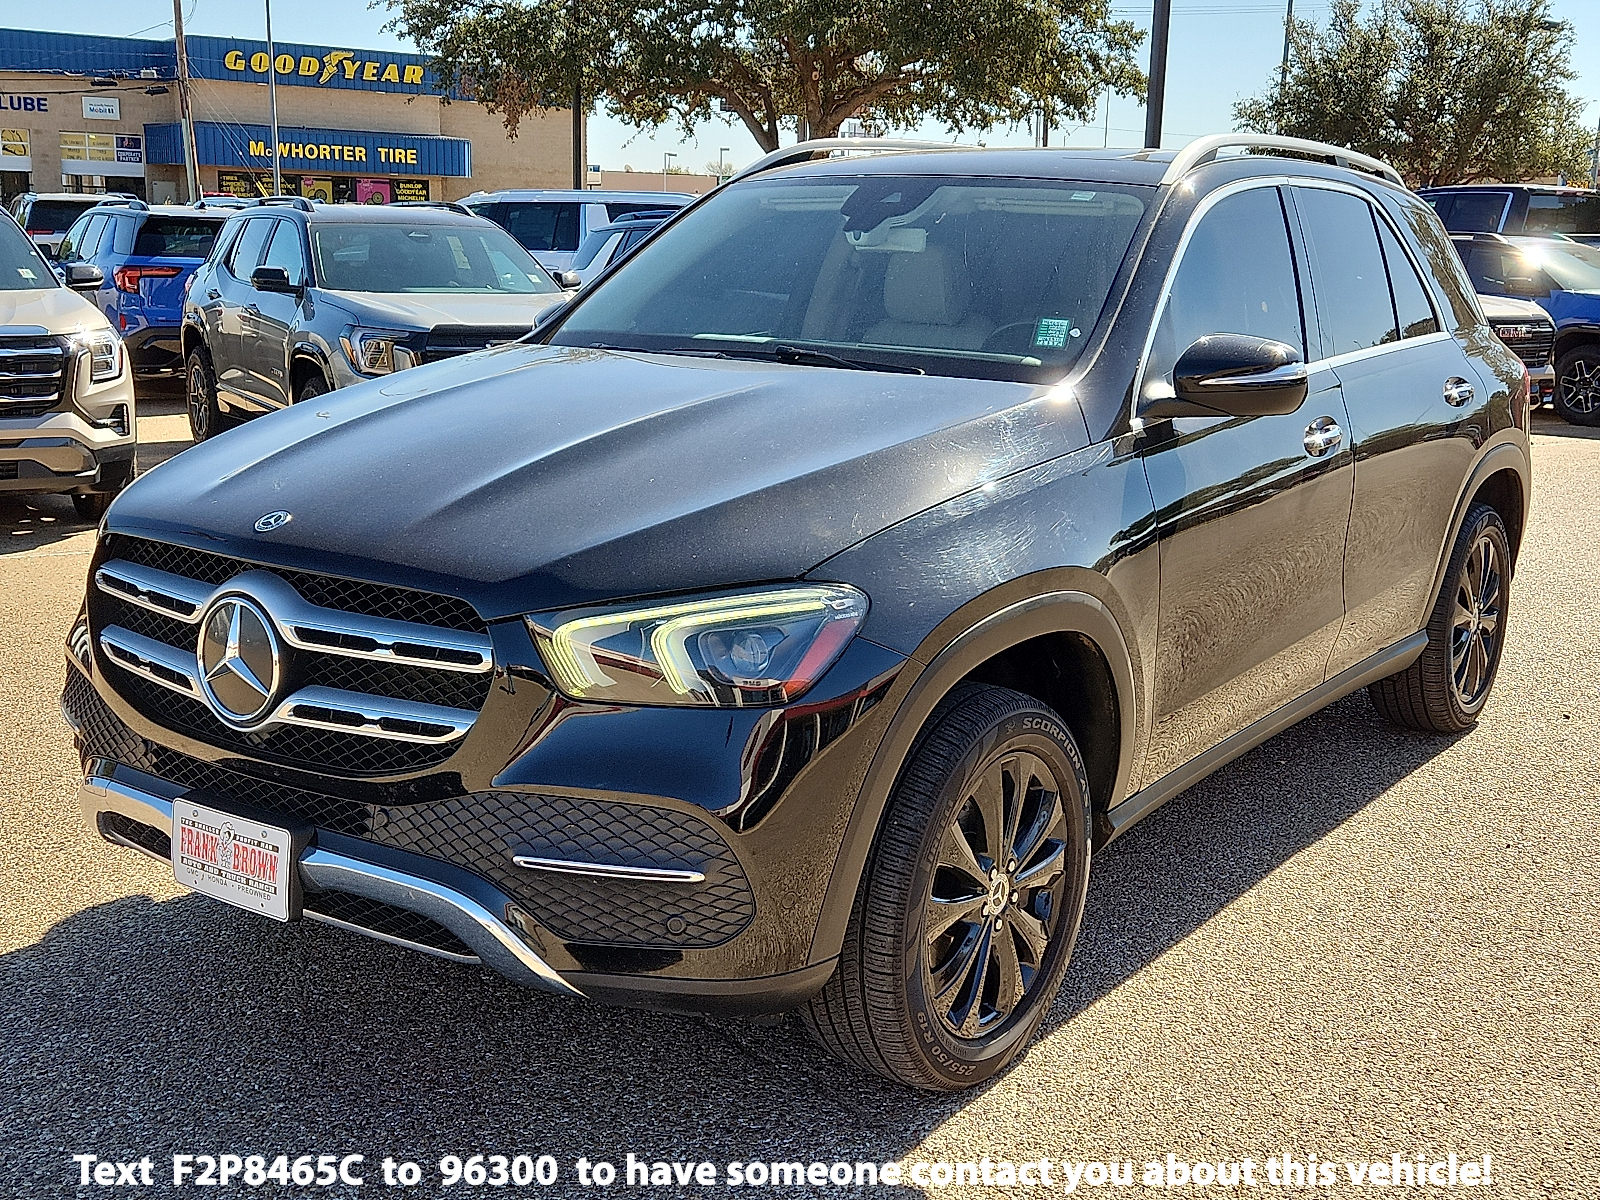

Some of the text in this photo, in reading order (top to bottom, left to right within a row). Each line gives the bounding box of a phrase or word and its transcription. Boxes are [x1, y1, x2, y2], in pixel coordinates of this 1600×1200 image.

[224, 50, 424, 84] GOODYEAR
[0, 95, 48, 112] LUBE
[89, 106, 107, 114] Mobil
[249, 140, 418, 164] McWHORTER TIRE
[1021, 716, 1081, 770] SCORPION
[180, 826, 279, 884] FRANK BROWN
[182, 857, 202, 871] AUTO
[203, 863, 220, 876] AND
[220, 869, 247, 884] TRUCK
[186, 867, 272, 901] GMC HONDA PREOWNED
